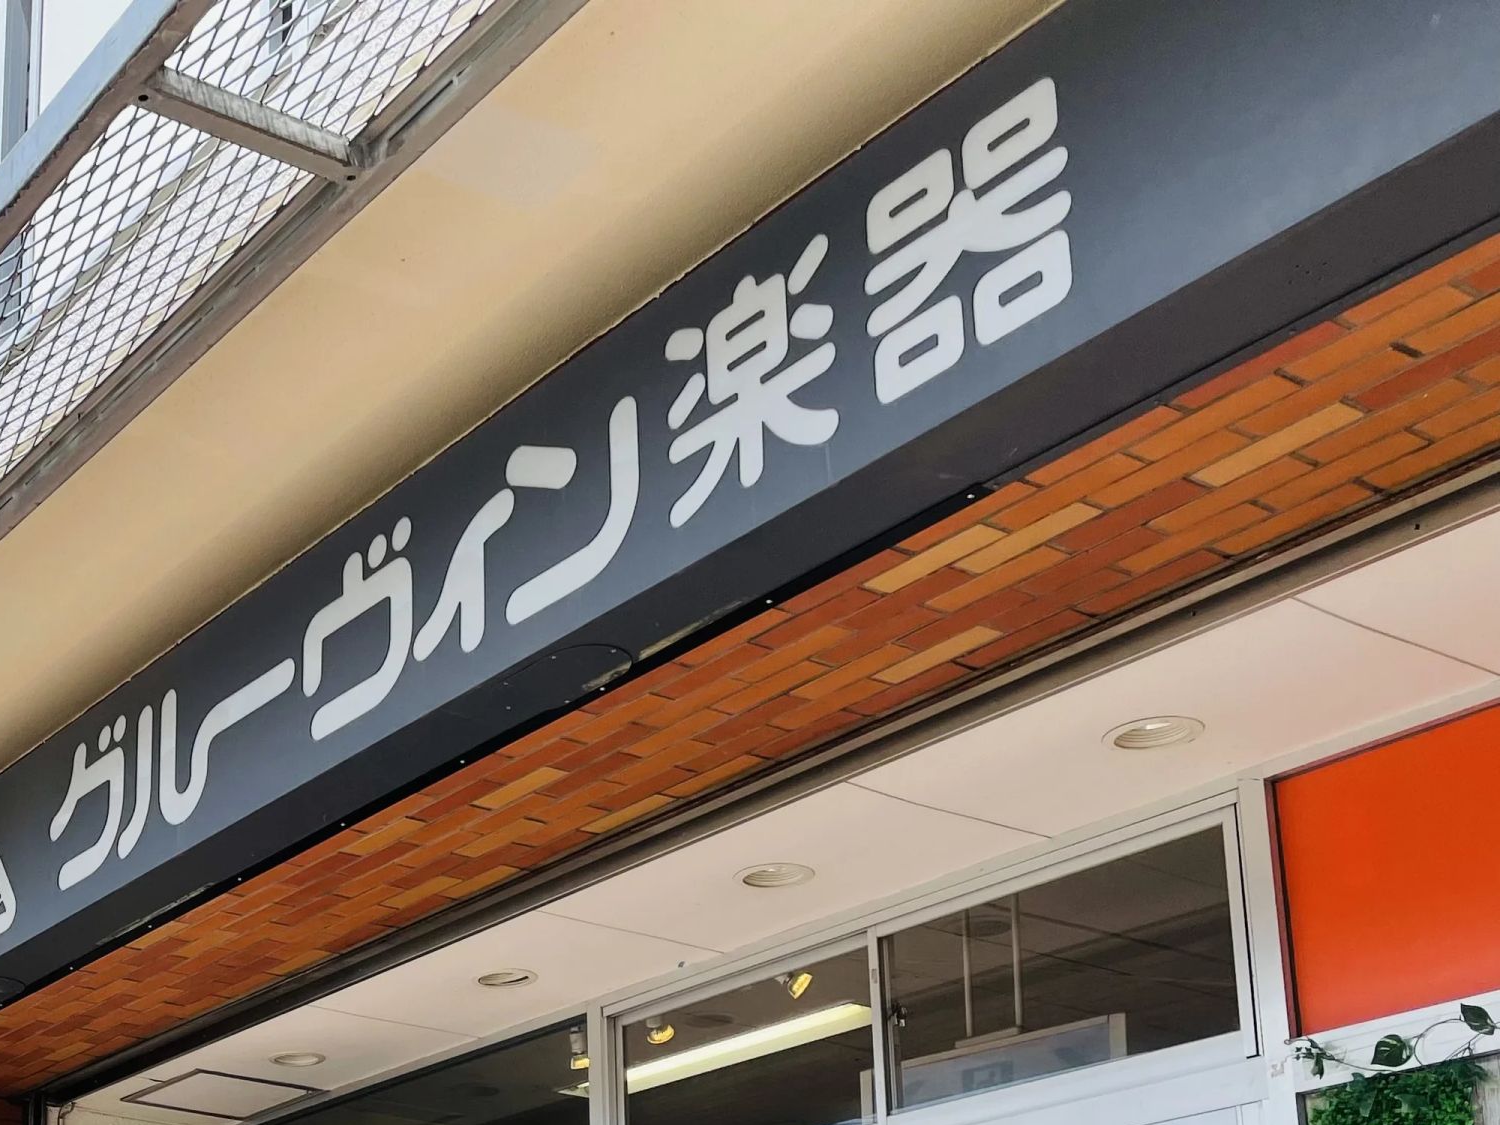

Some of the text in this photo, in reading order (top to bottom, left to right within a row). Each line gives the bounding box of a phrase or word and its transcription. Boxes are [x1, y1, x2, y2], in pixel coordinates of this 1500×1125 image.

[50, 77, 1073, 890] グルーヴィン楽器
